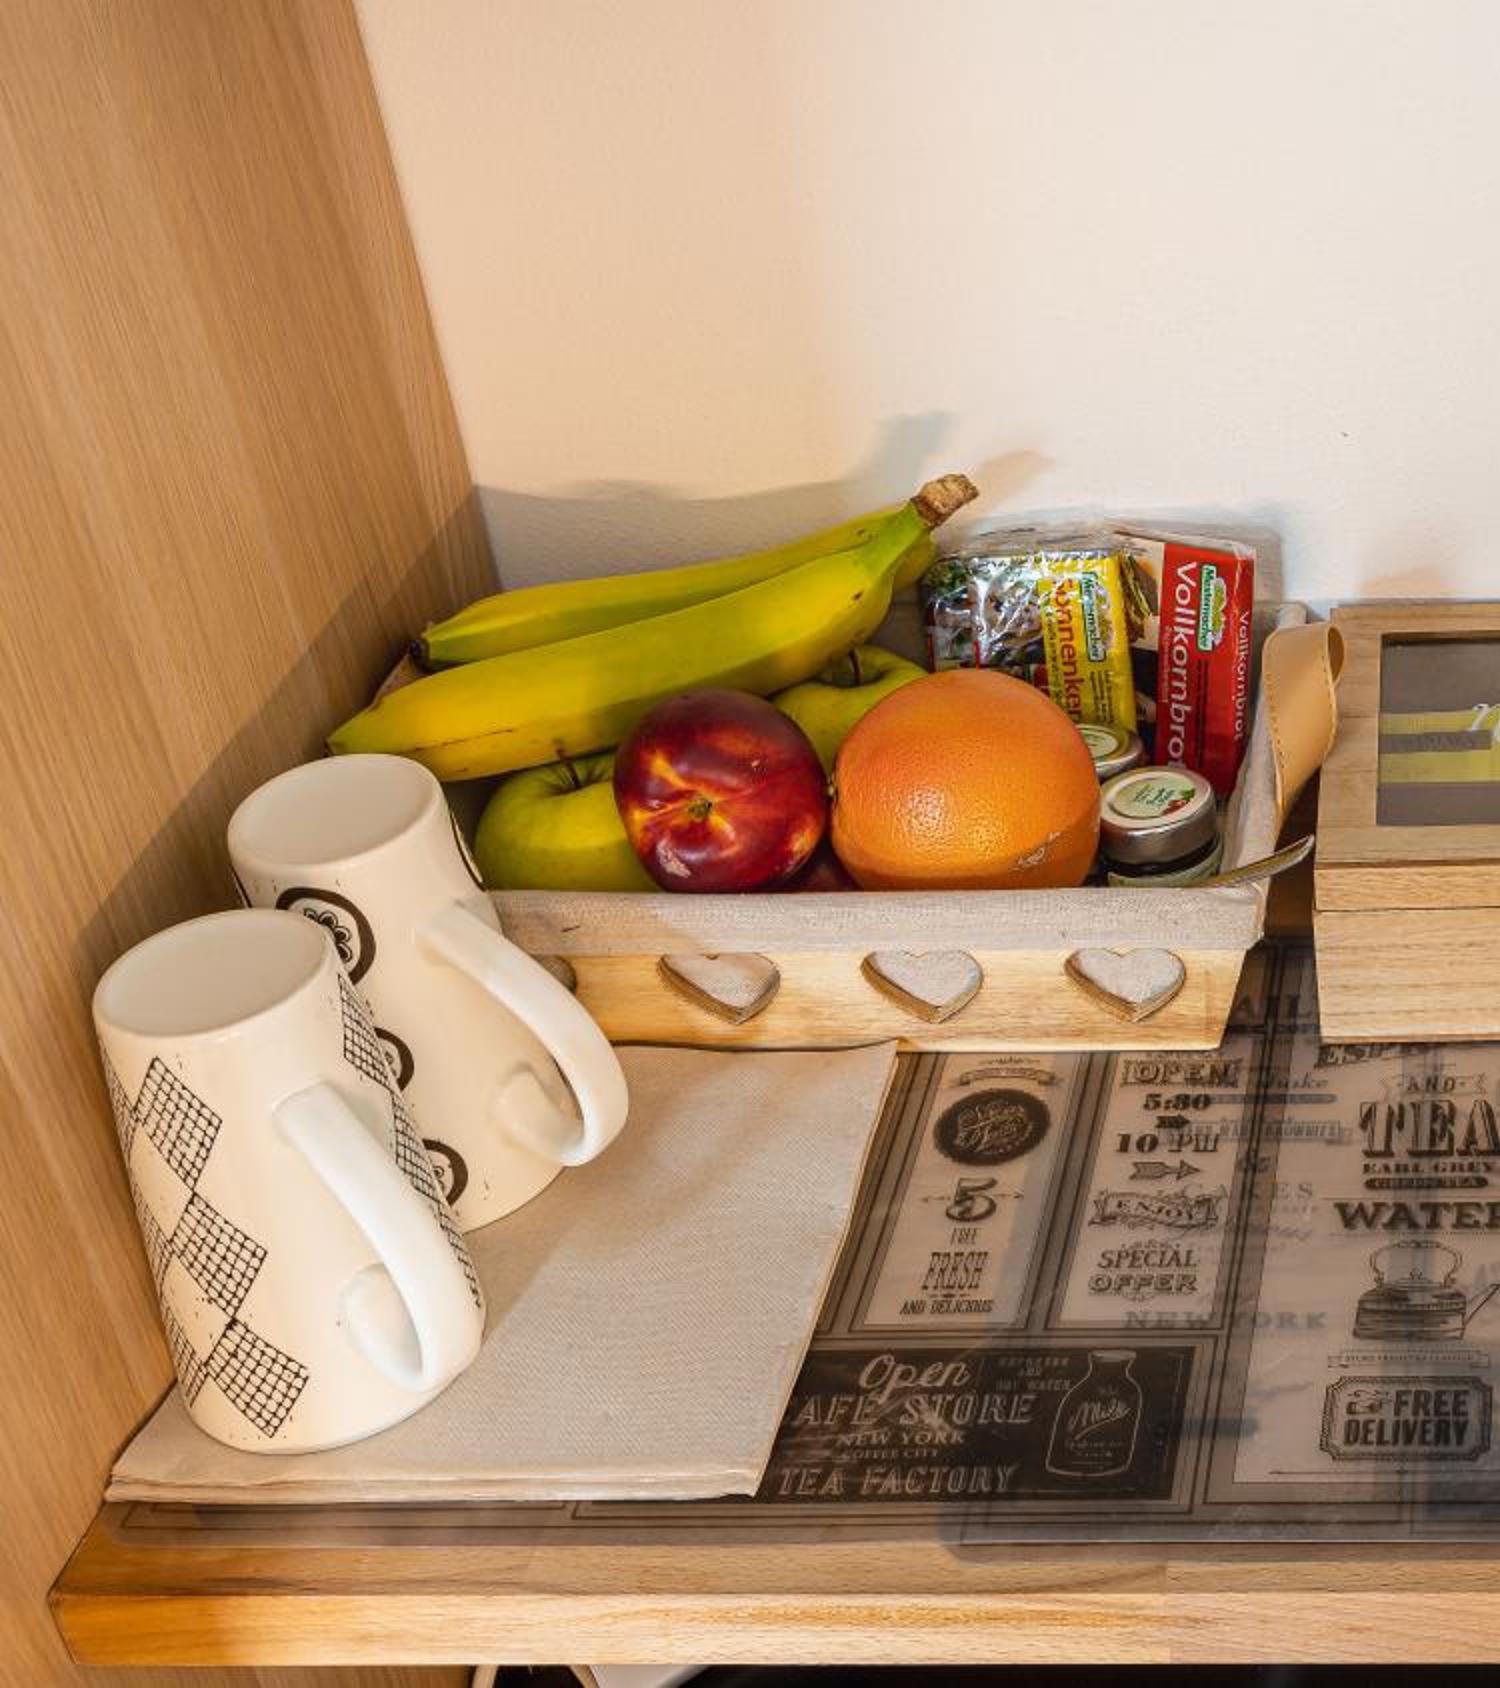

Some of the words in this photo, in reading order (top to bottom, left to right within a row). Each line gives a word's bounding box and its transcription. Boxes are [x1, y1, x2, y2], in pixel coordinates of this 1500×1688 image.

[1116, 1133, 1160, 1153] 10
[945, 1176, 999, 1223] 5
[921, 1251, 989, 1290] FRESH
[1097, 1249, 1199, 1269] SPECIAL
[1087, 1272, 1199, 1294] OFFER
[858, 1354, 971, 1405] Open
[899, 1394, 1038, 1426] STORE
[1393, 1389, 1471, 1417] FREE
[901, 1429, 967, 1445] YORK
[1343, 1418, 1470, 1447] DELIVERY
[776, 1467, 846, 1496] TEA
[860, 1462, 1021, 1495] FACTORY
